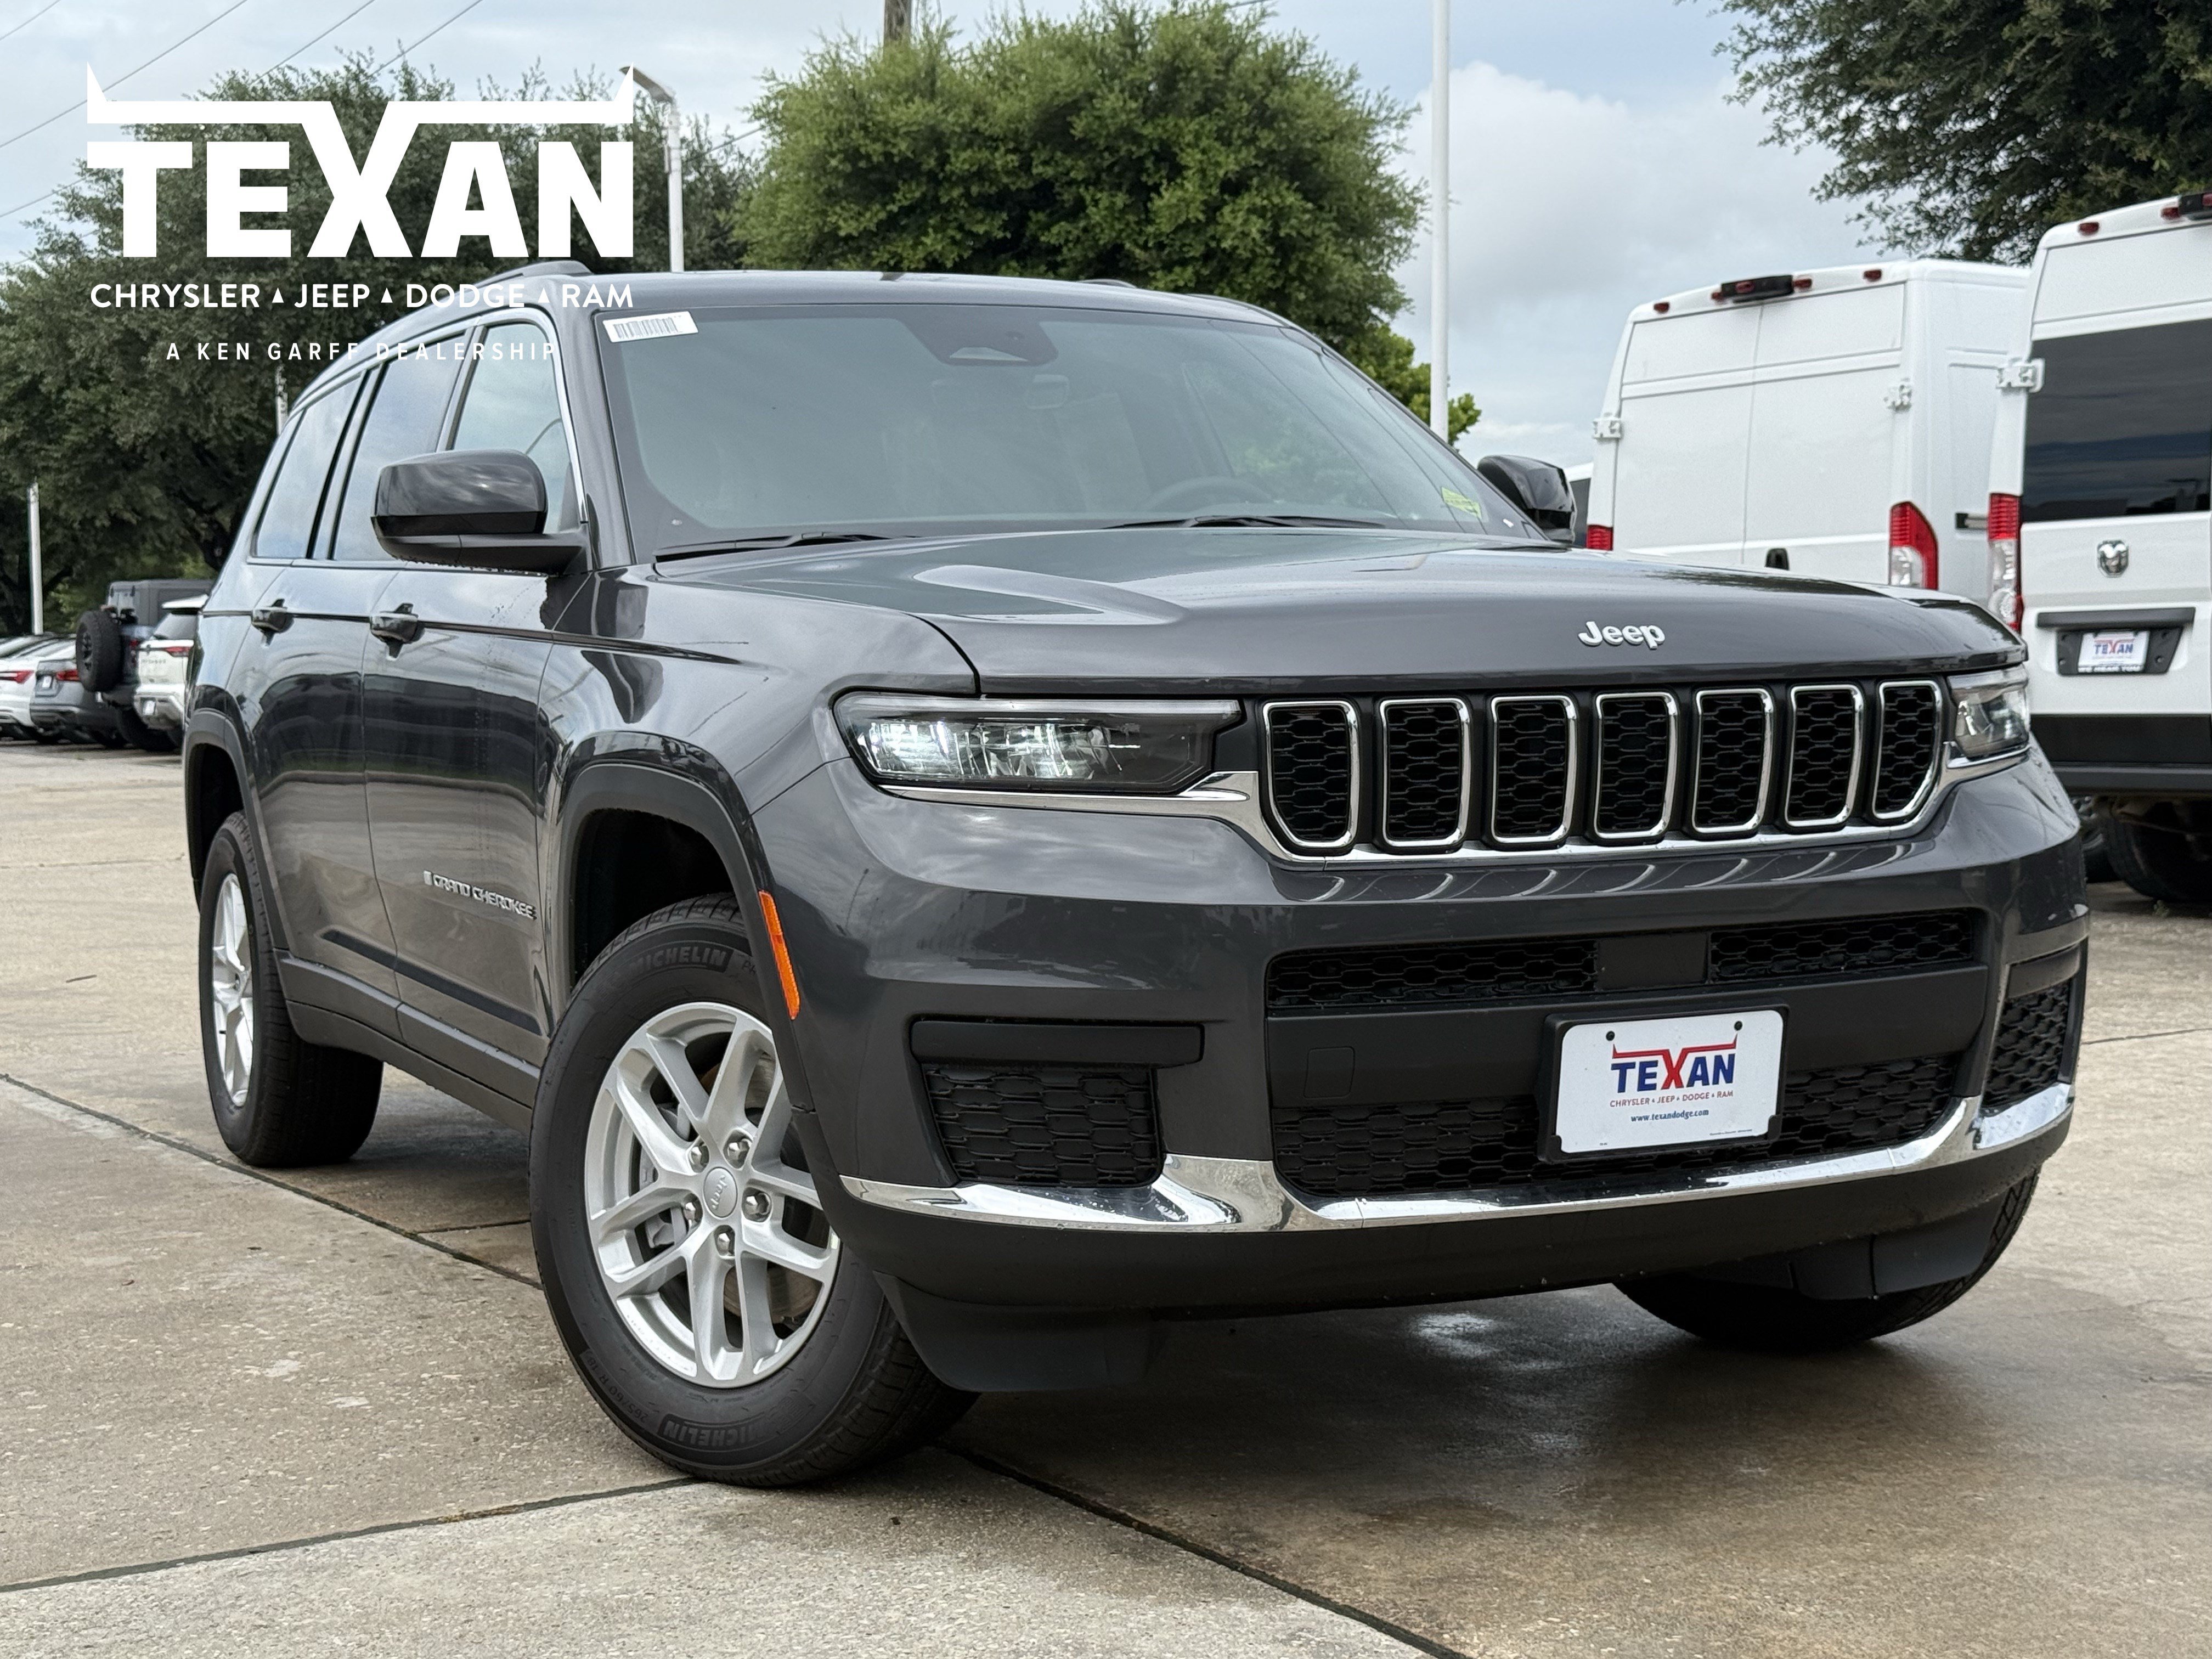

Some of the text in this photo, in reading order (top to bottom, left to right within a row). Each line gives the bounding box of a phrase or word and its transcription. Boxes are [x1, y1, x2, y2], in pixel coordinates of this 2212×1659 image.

[1578, 621, 1666, 649] Jeep
[2094, 639, 2134, 654] TEXAN
[433, 874, 537, 920] GRAND CHEROKEE
[629, 946, 726, 972] MICHELIN
[1611, 1045, 1736, 1093] TEXAN
[1610, 1090, 1734, 1108] CHRYSLER JEEP DODGE RAM
[1630, 1109, 1709, 1122] www.texandodge.com
[586, 1357, 648, 1423] 265/60 R 18
[665, 1421, 763, 1446] MICHELIN
